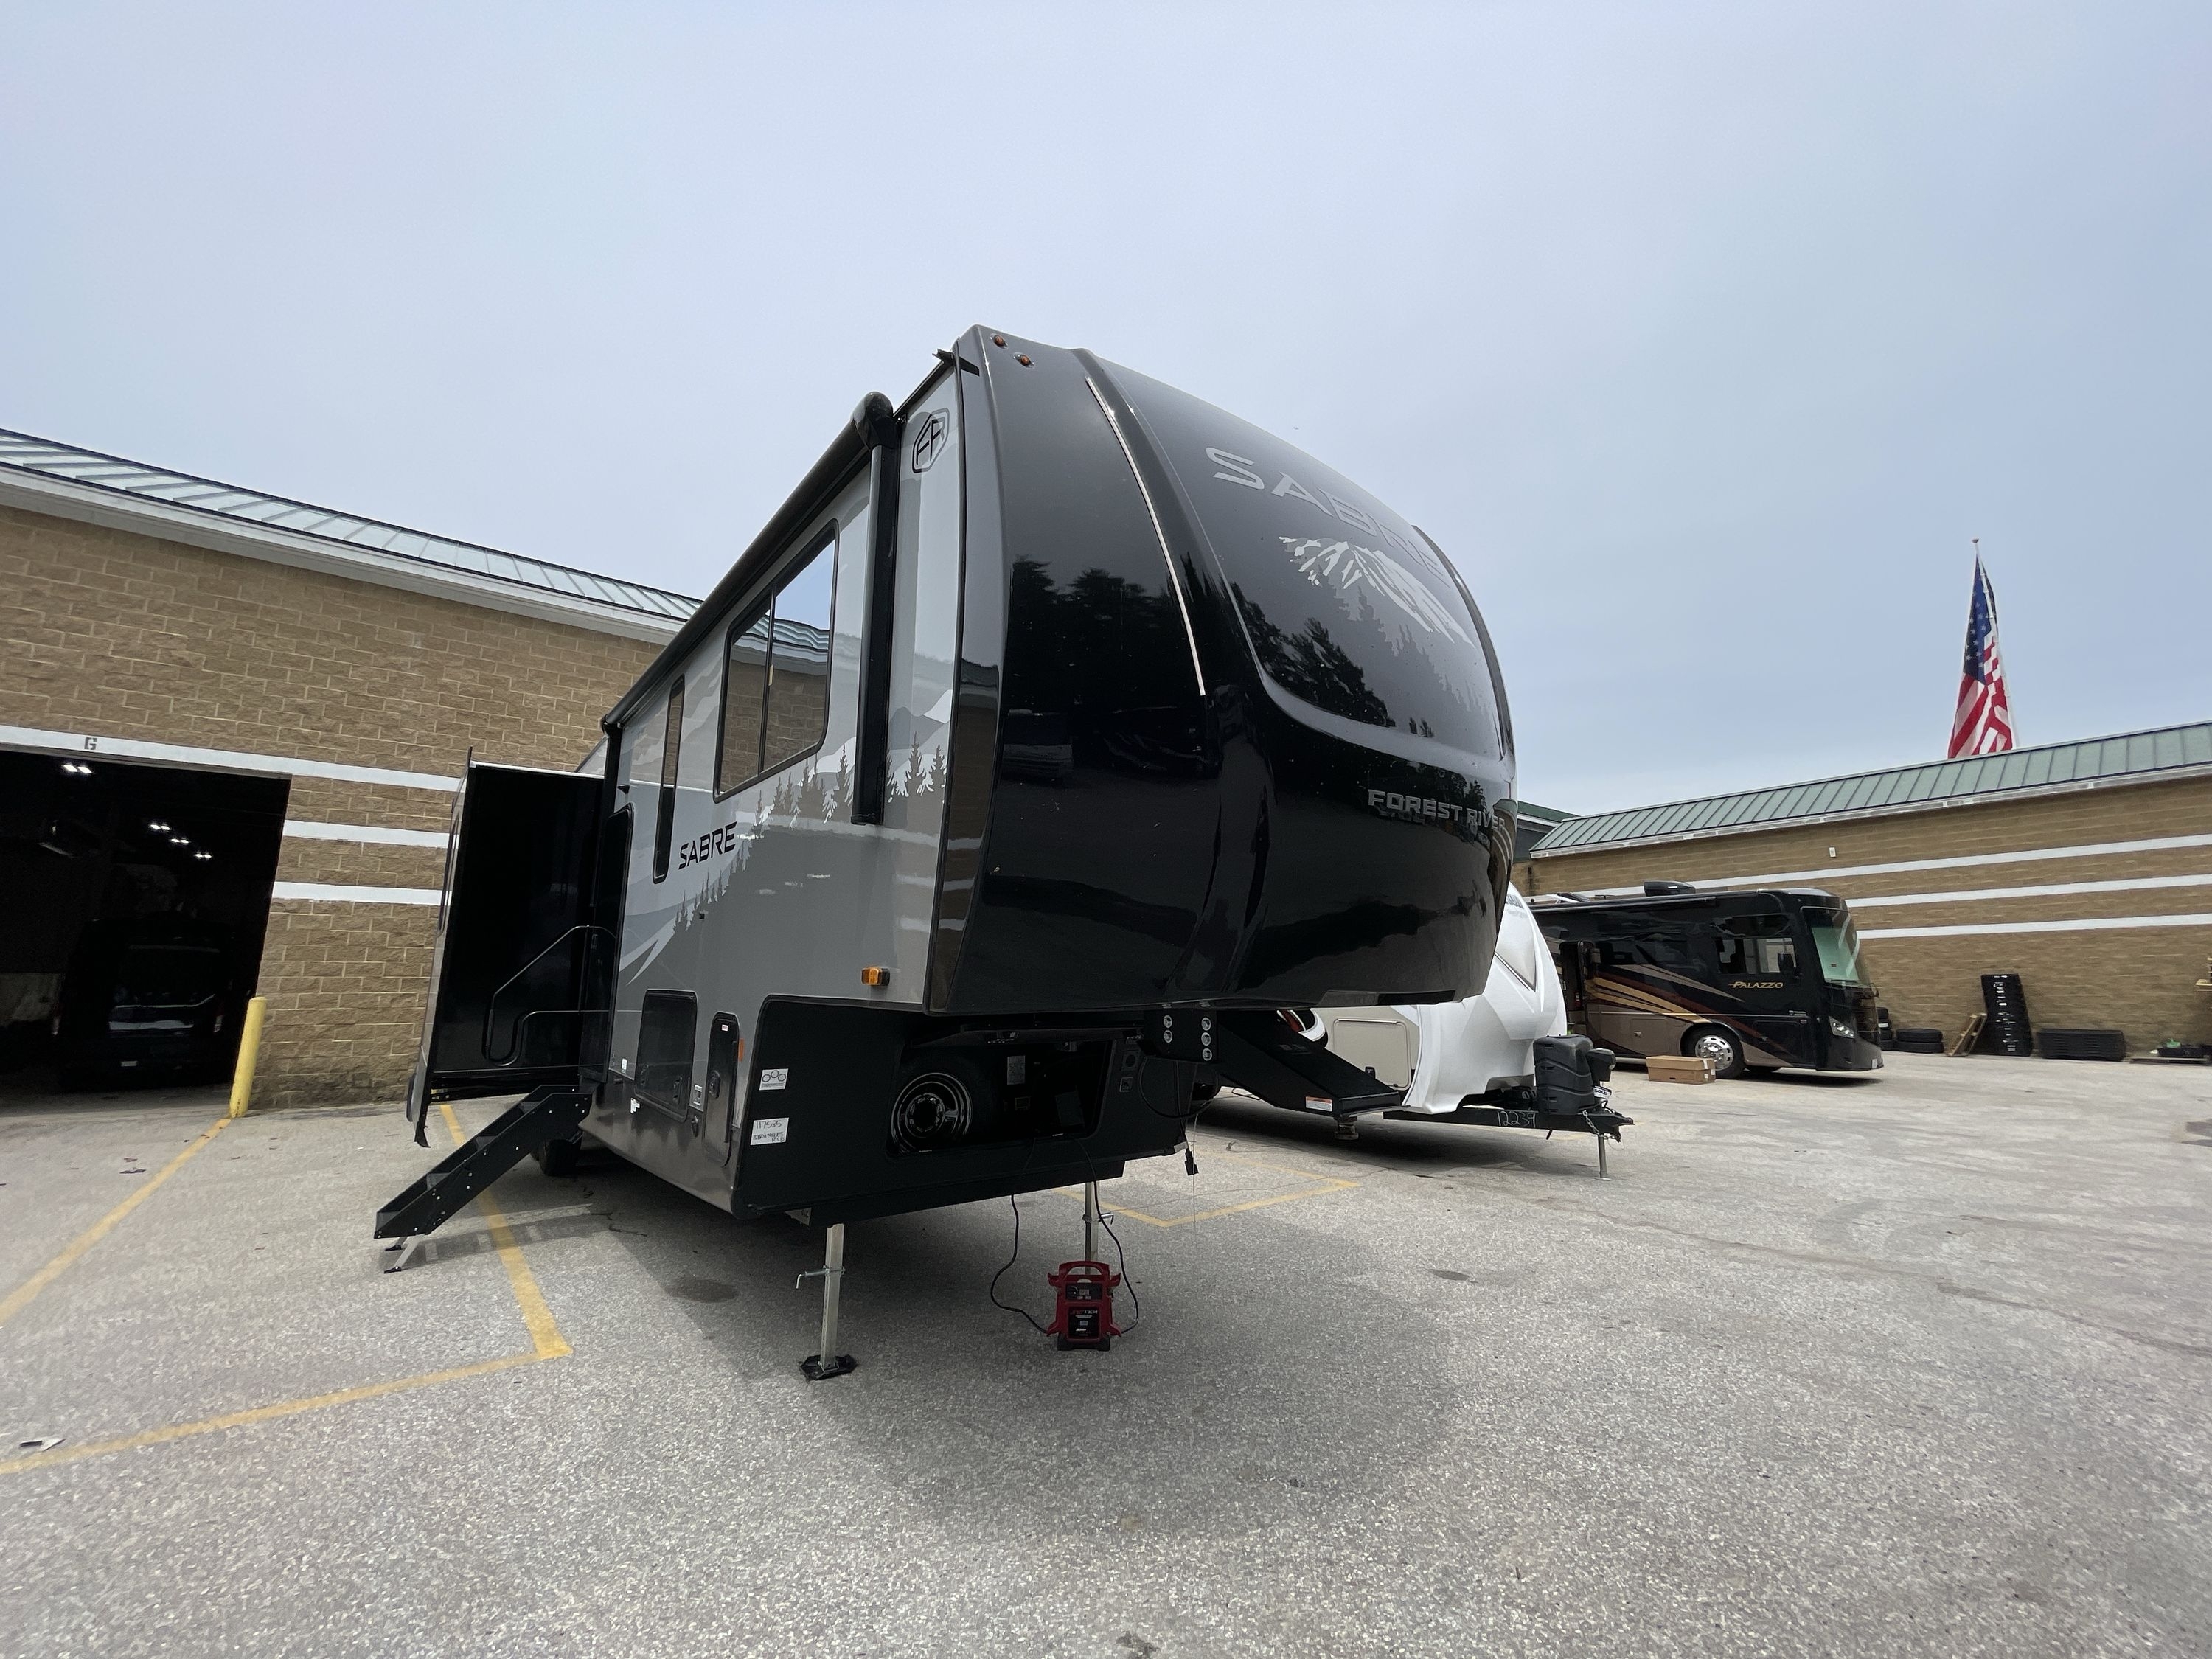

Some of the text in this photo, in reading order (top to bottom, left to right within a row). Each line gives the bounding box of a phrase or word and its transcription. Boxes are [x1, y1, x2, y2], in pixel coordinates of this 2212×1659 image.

[1206, 447, 1450, 588] SABRE
[84, 737, 97, 750] G
[1368, 789, 1505, 832] FOREST RIVER
[678, 821, 737, 870] SABRE
[1498, 1110, 1535, 1127] 12239
